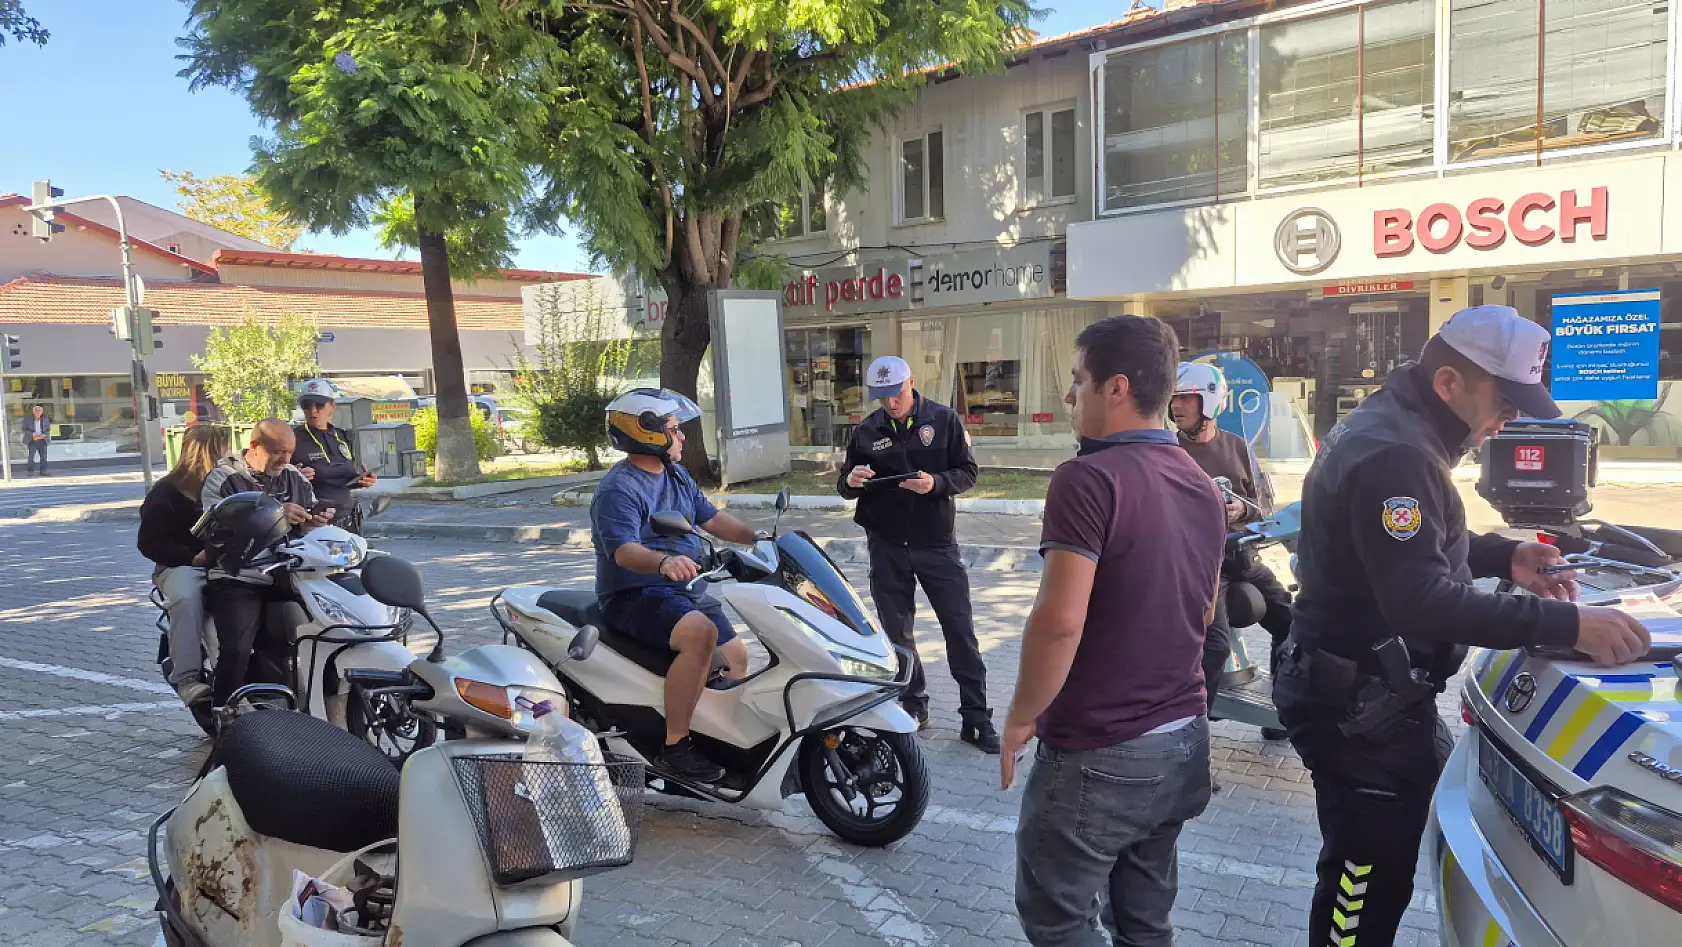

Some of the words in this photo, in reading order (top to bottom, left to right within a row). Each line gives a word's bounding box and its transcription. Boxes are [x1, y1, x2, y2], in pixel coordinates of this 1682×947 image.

[1373, 186, 1608, 259] BOSCH
[825, 267, 903, 312] perde
[1562, 314, 1623, 324] MAĞAZAMIZA
[1625, 312, 1649, 321] ÖZEL
[1555, 323, 1604, 336] BÜYÜK
[1605, 322, 1657, 335] FIRSAT
[156, 374, 186, 387] BÜYÜK
[1519, 449, 1541, 461] 112
[1524, 783, 1562, 857] 8358
